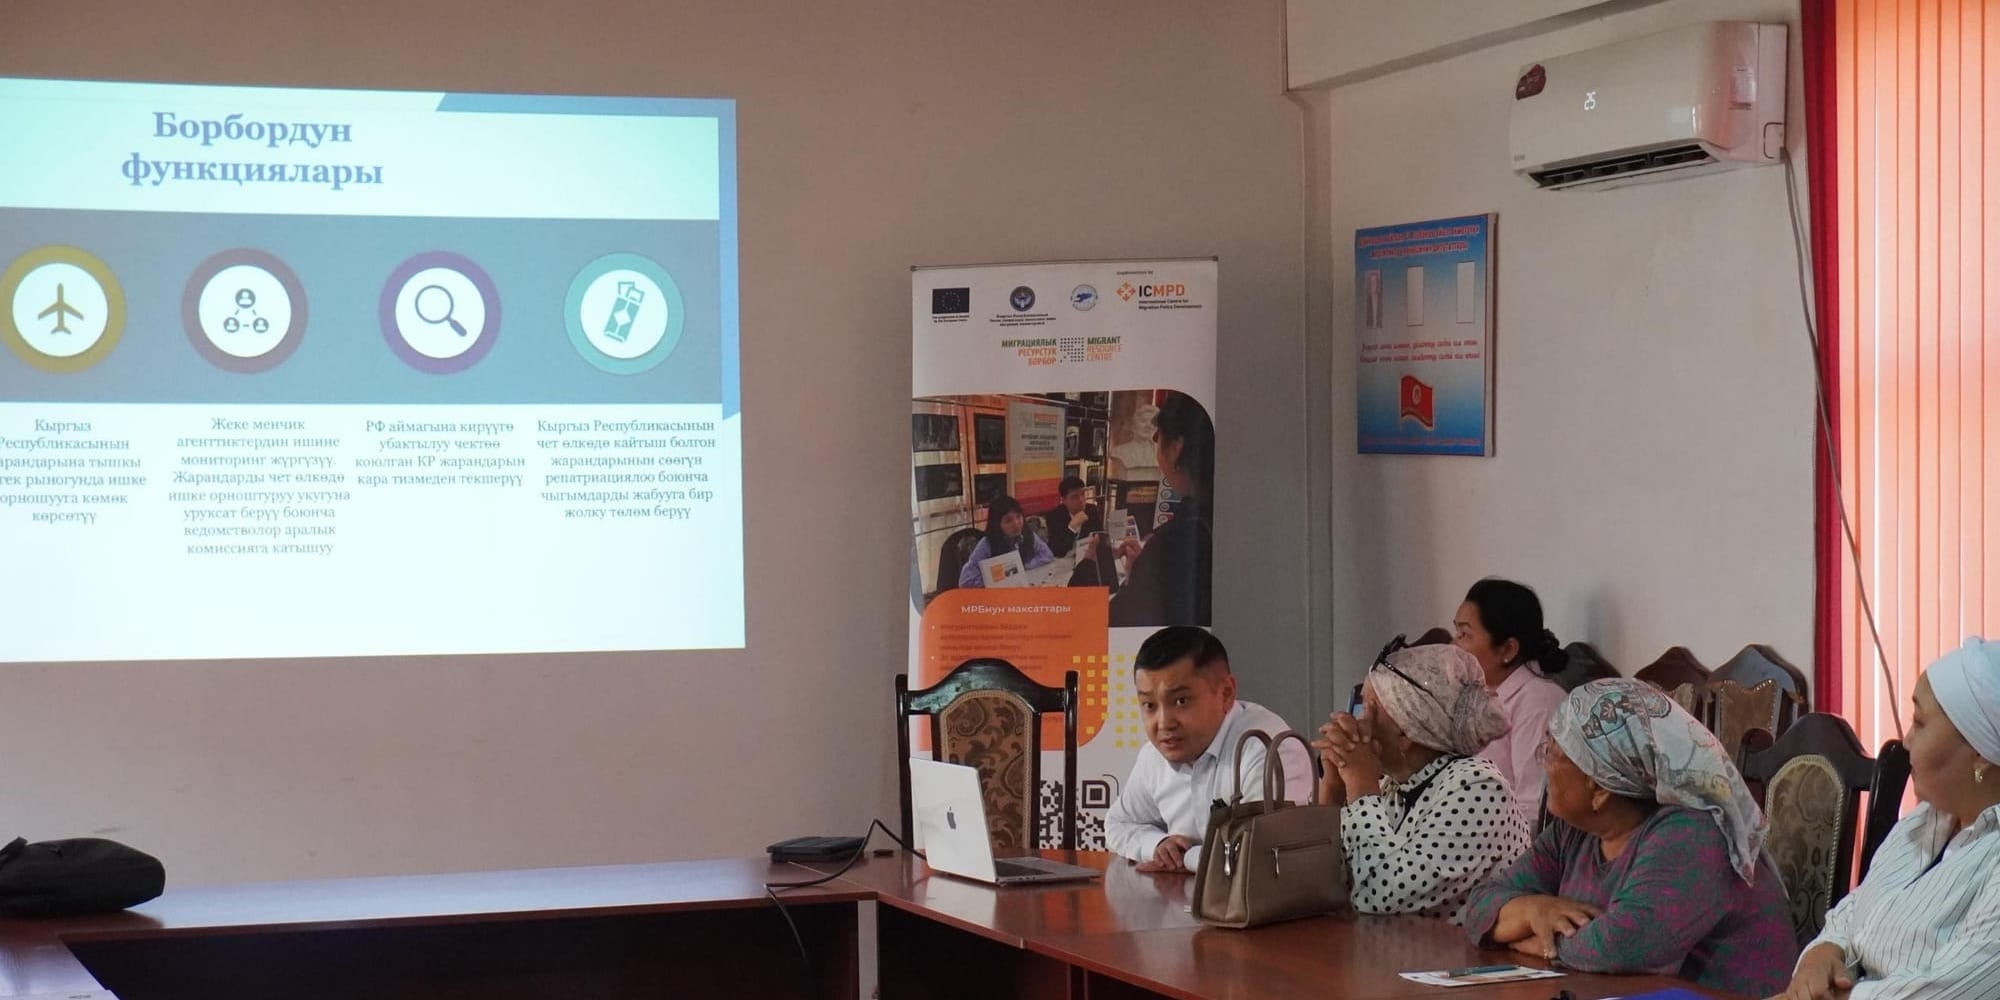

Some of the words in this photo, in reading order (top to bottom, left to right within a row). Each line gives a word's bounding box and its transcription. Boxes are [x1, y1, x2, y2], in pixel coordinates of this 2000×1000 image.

[152, 111, 352, 148] Борбордун
[121, 152, 384, 190] функциялары
[1138, 284, 1185, 298] ICMPD
[1001, 338, 1057, 348] МИГРАЦИЯЛЫК
[1087, 336, 1121, 345] MIGRANT
[1018, 348, 1057, 358] РЕСУРСТУК
[1028, 357, 1057, 366] БОРБОР
[34, 418, 92, 435] Кыргыз
[211, 417, 249, 430] Жеке
[253, 419, 306, 430] менчик
[366, 419, 386, 433] РФ
[389, 419, 457, 433] аймагына
[460, 421, 515, 436] кирүүгө
[537, 419, 591, 435] Кыргыз
[594, 419, 715, 434] Республикасынын
[176, 437, 289, 450] агенттиктердин
[293, 437, 341, 448] ишине
[379, 437, 451, 452] убактылуу
[454, 439, 501, 450] чектөө
[536, 438, 560, 449] чет
[562, 438, 611, 450] өлкөдө
[614, 436, 667, 449] кайтыш
[670, 435, 716, 448] болгон
[89, 457, 141, 468] тышкы
[181, 455, 267, 468] мониторинг
[271, 455, 337, 469] жүргүзүү.
[355, 457, 414, 468] коюлган
[417, 455, 436, 468] КР
[439, 456, 526, 470] жарандарын
[550, 456, 655, 469] жарандарынын
[658, 455, 703, 468] сөөгүн
[26, 475, 105, 488] рыногунда
[108, 475, 147, 486] ишке
[173, 471, 265, 486] Жарандарды
[268, 474, 291, 484] чет
[295, 474, 345, 485] өлкөдө
[357, 474, 389, 488] кара
[393, 474, 456, 486] тизмеден
[459, 473, 524, 487] текшерүү
[545, 473, 656, 487] репатриациялоо
[658, 470, 709, 483] боюнча
[0, 494, 78, 507] орношууга
[82, 494, 129, 504] көмөк
[168, 490, 207, 502] ишке
[209, 491, 294, 504] орноштуруу
[296, 489, 351, 504] укугуна
[541, 490, 629, 503] чыгымдарды
[632, 488, 686, 502] жабууга
[688, 487, 714, 502] бир
[32, 511, 97, 525] көрсөтүү
[183, 508, 237, 522] уруксат
[240, 506, 280, 521] берүү
[283, 506, 336, 519] боюнча
[564, 508, 607, 521] жолку
[609, 507, 651, 518] төлөм
[654, 504, 692, 520] берүү
[184, 526, 282, 539] ведомстволор
[284, 525, 337, 539] аралык
[187, 543, 269, 555] комиссияга
[272, 542, 334, 556] катышуу
[960, 605, 1005, 615] МРБнун
[1007, 603, 1072, 615] максаттары
